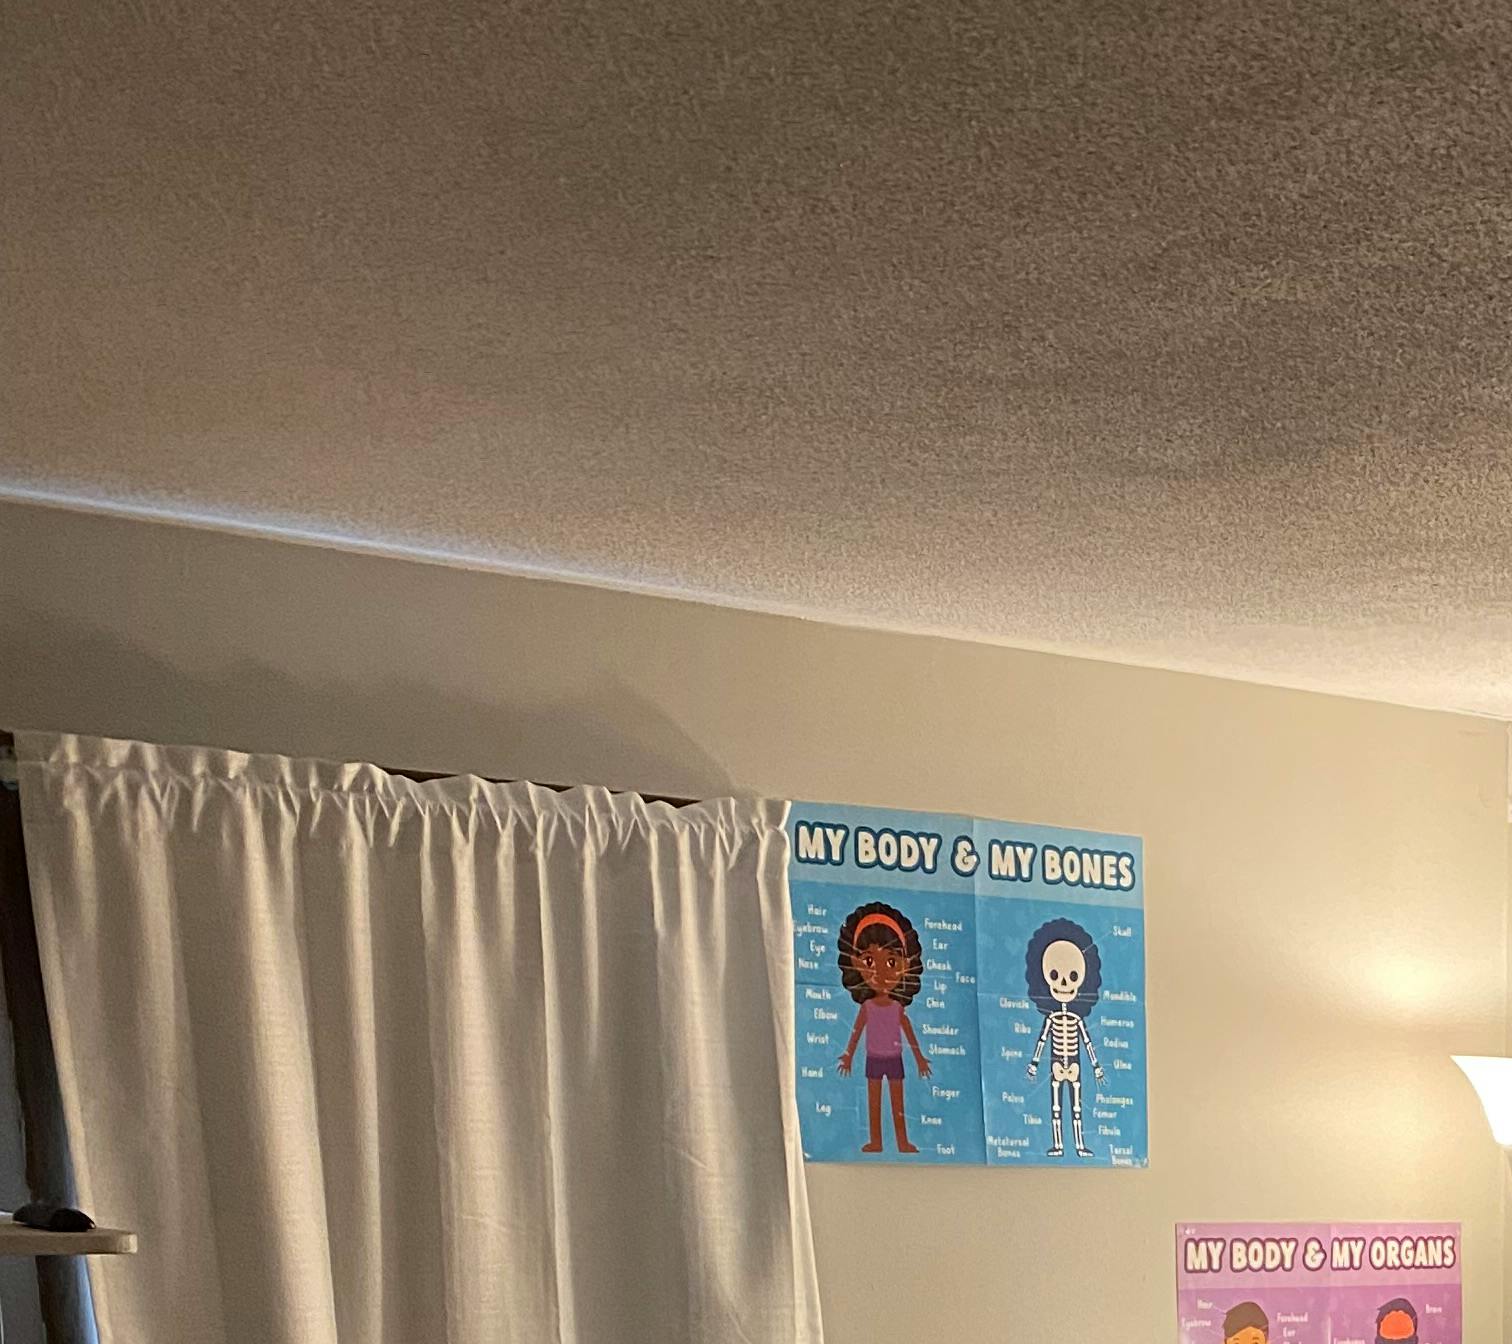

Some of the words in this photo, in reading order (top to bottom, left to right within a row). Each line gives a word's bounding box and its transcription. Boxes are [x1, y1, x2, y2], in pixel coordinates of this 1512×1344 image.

[796, 822, 848, 864] MY
[855, 828, 941, 874] BODY
[952, 836, 980, 875] &
[989, 840, 1036, 881] MY
[1042, 847, 1136, 890] BONES
[807, 904, 827, 916] Hair
[810, 940, 826, 957] Eye
[932, 938, 948, 950] Ear
[801, 1067, 823, 1079] Hand
[931, 1086, 960, 1100] Finger
[816, 1102, 832, 1117] Leg
[936, 1144, 955, 1155] Foot
[1186, 1239, 1224, 1272] MY
[1232, 1239, 1298, 1271] BODY
[1304, 1239, 1326, 1271] &
[1331, 1238, 1366, 1270] MY
[1369, 1237, 1456, 1269] ORGANS
